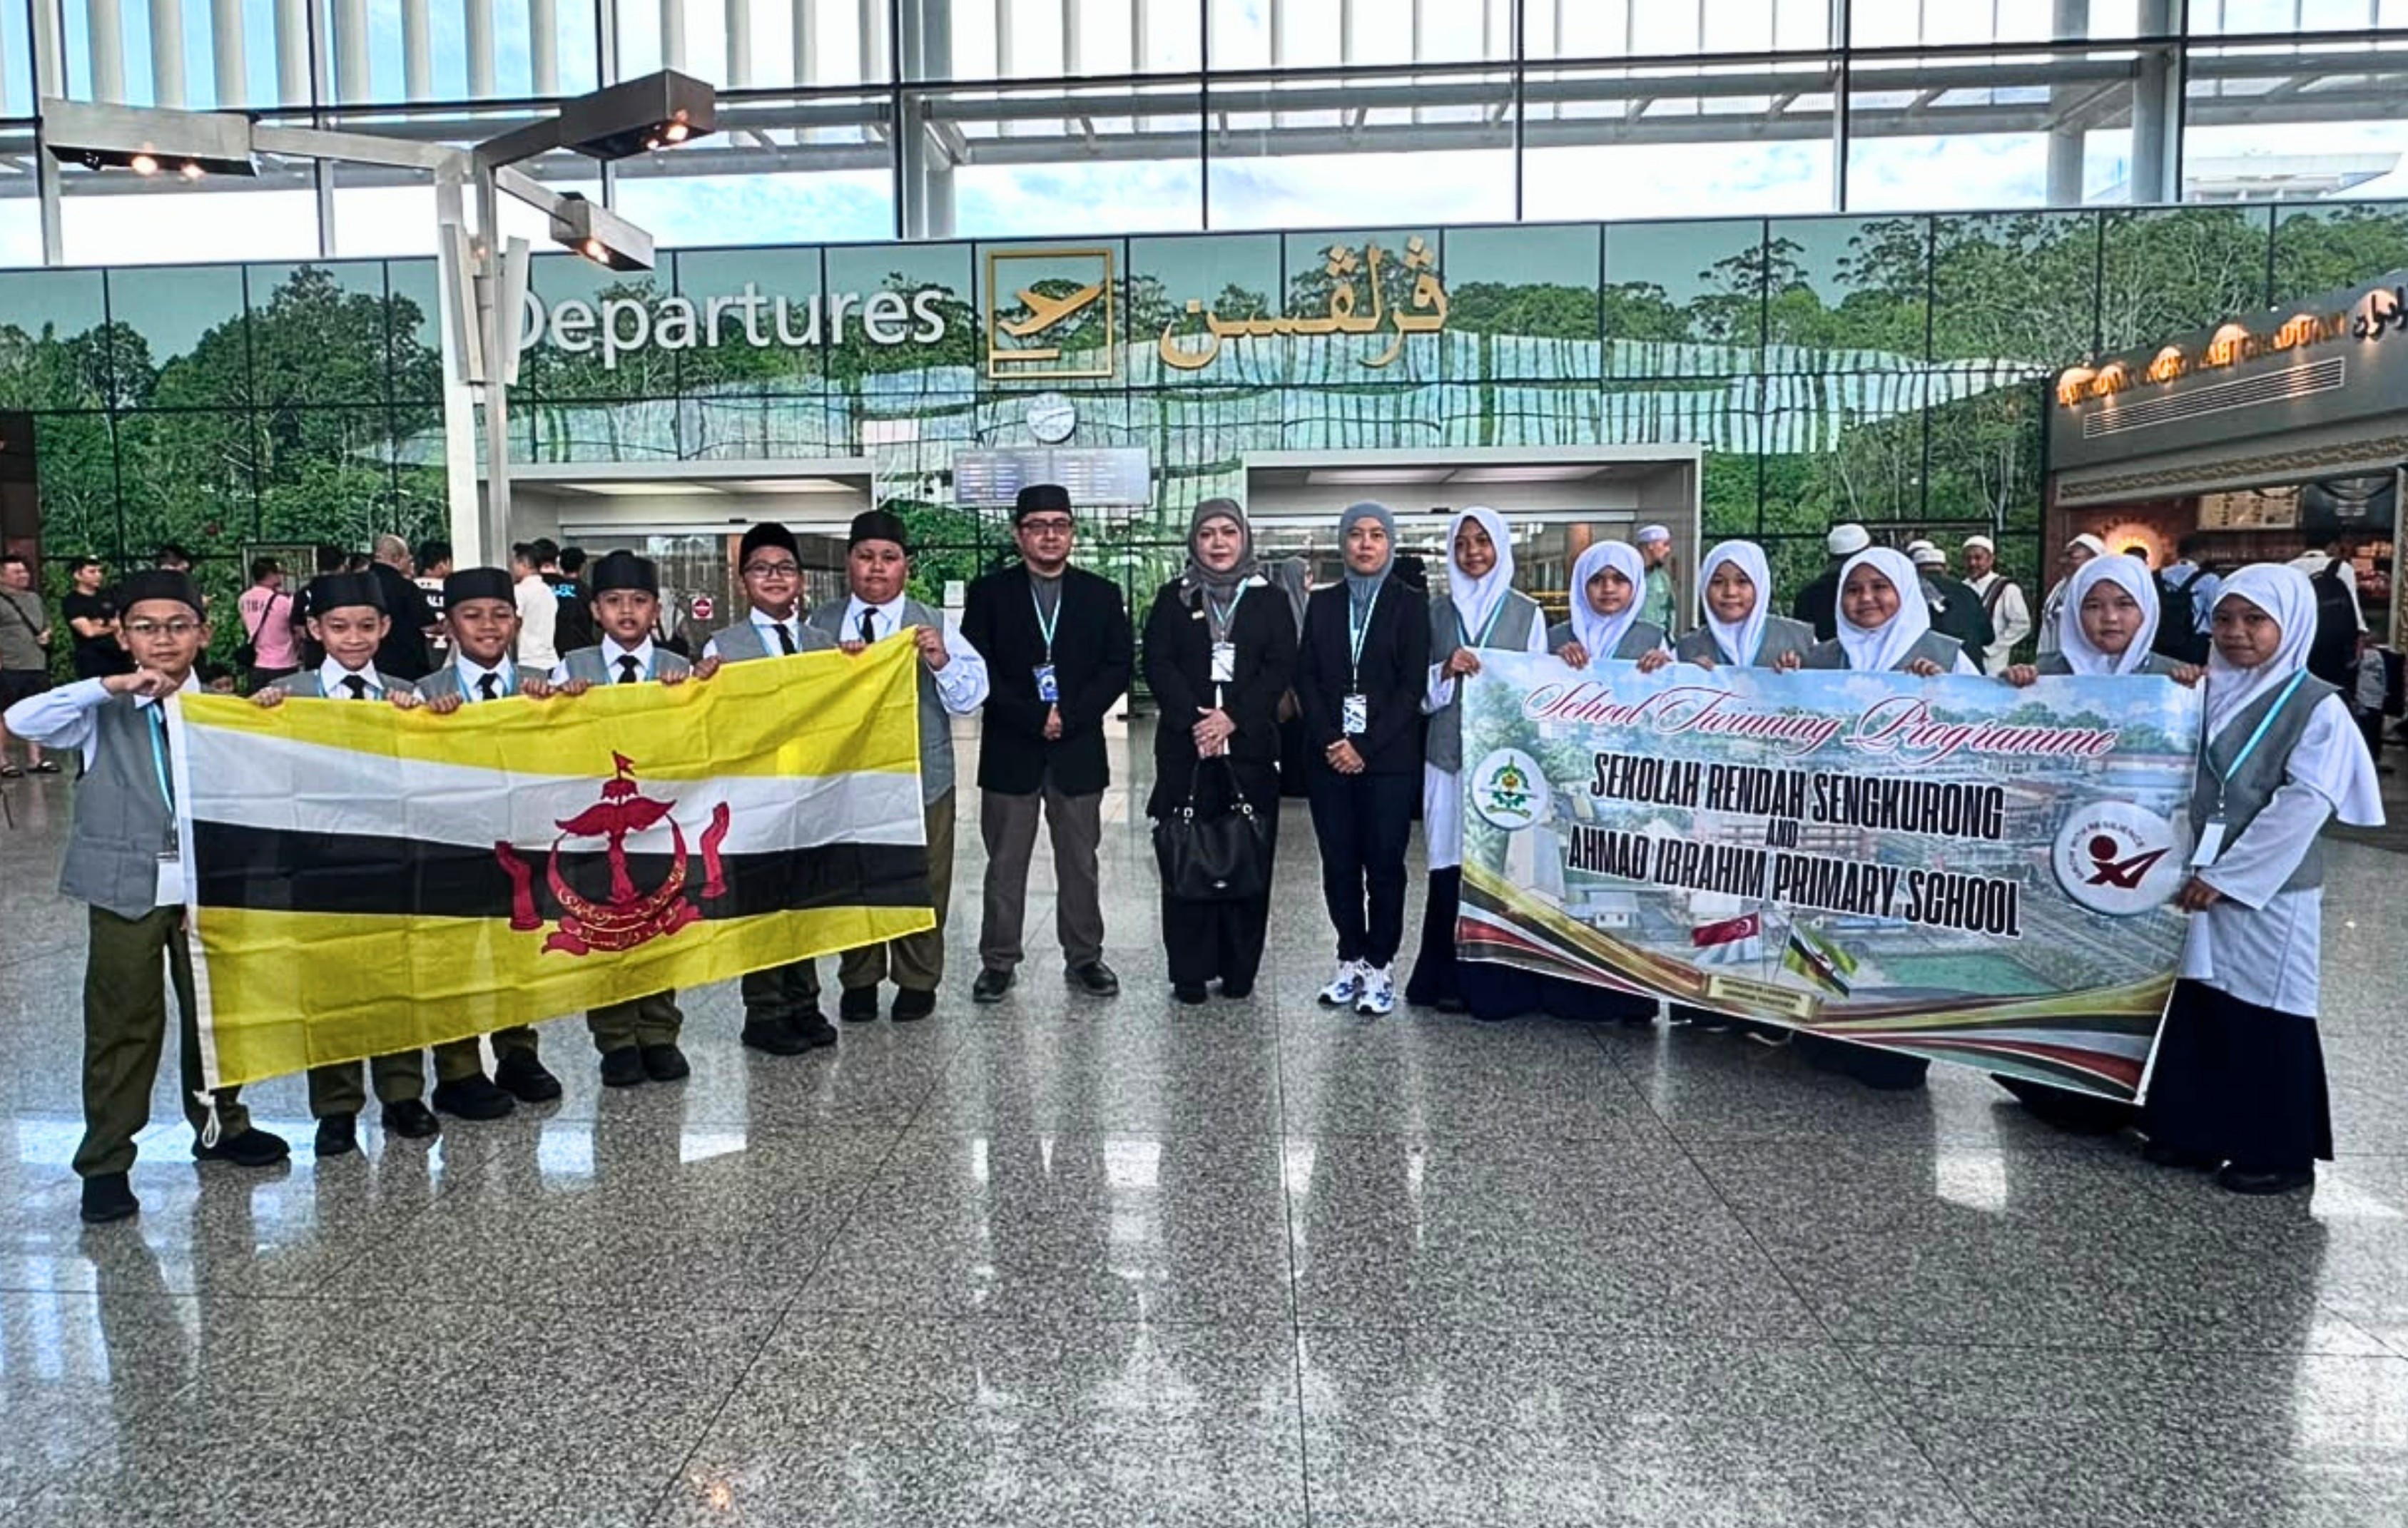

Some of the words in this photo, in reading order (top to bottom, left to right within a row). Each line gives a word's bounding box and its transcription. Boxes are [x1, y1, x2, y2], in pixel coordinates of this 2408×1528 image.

[1524, 681, 1662, 725] School
[1657, 686, 1841, 756] Twinning
[1844, 696, 2117, 766] Programme
[1590, 752, 1702, 808] SEKOLAH
[1705, 763, 1806, 819] RENDAH
[1812, 773, 2004, 840] SENGKURONG
[1765, 819, 1799, 850] AND
[1568, 825, 1650, 880] AHMAD
[1654, 838, 1767, 899] IBRAHIM
[1771, 852, 1899, 917] PRIMARY
[1904, 870, 2021, 937] SCHOOL
